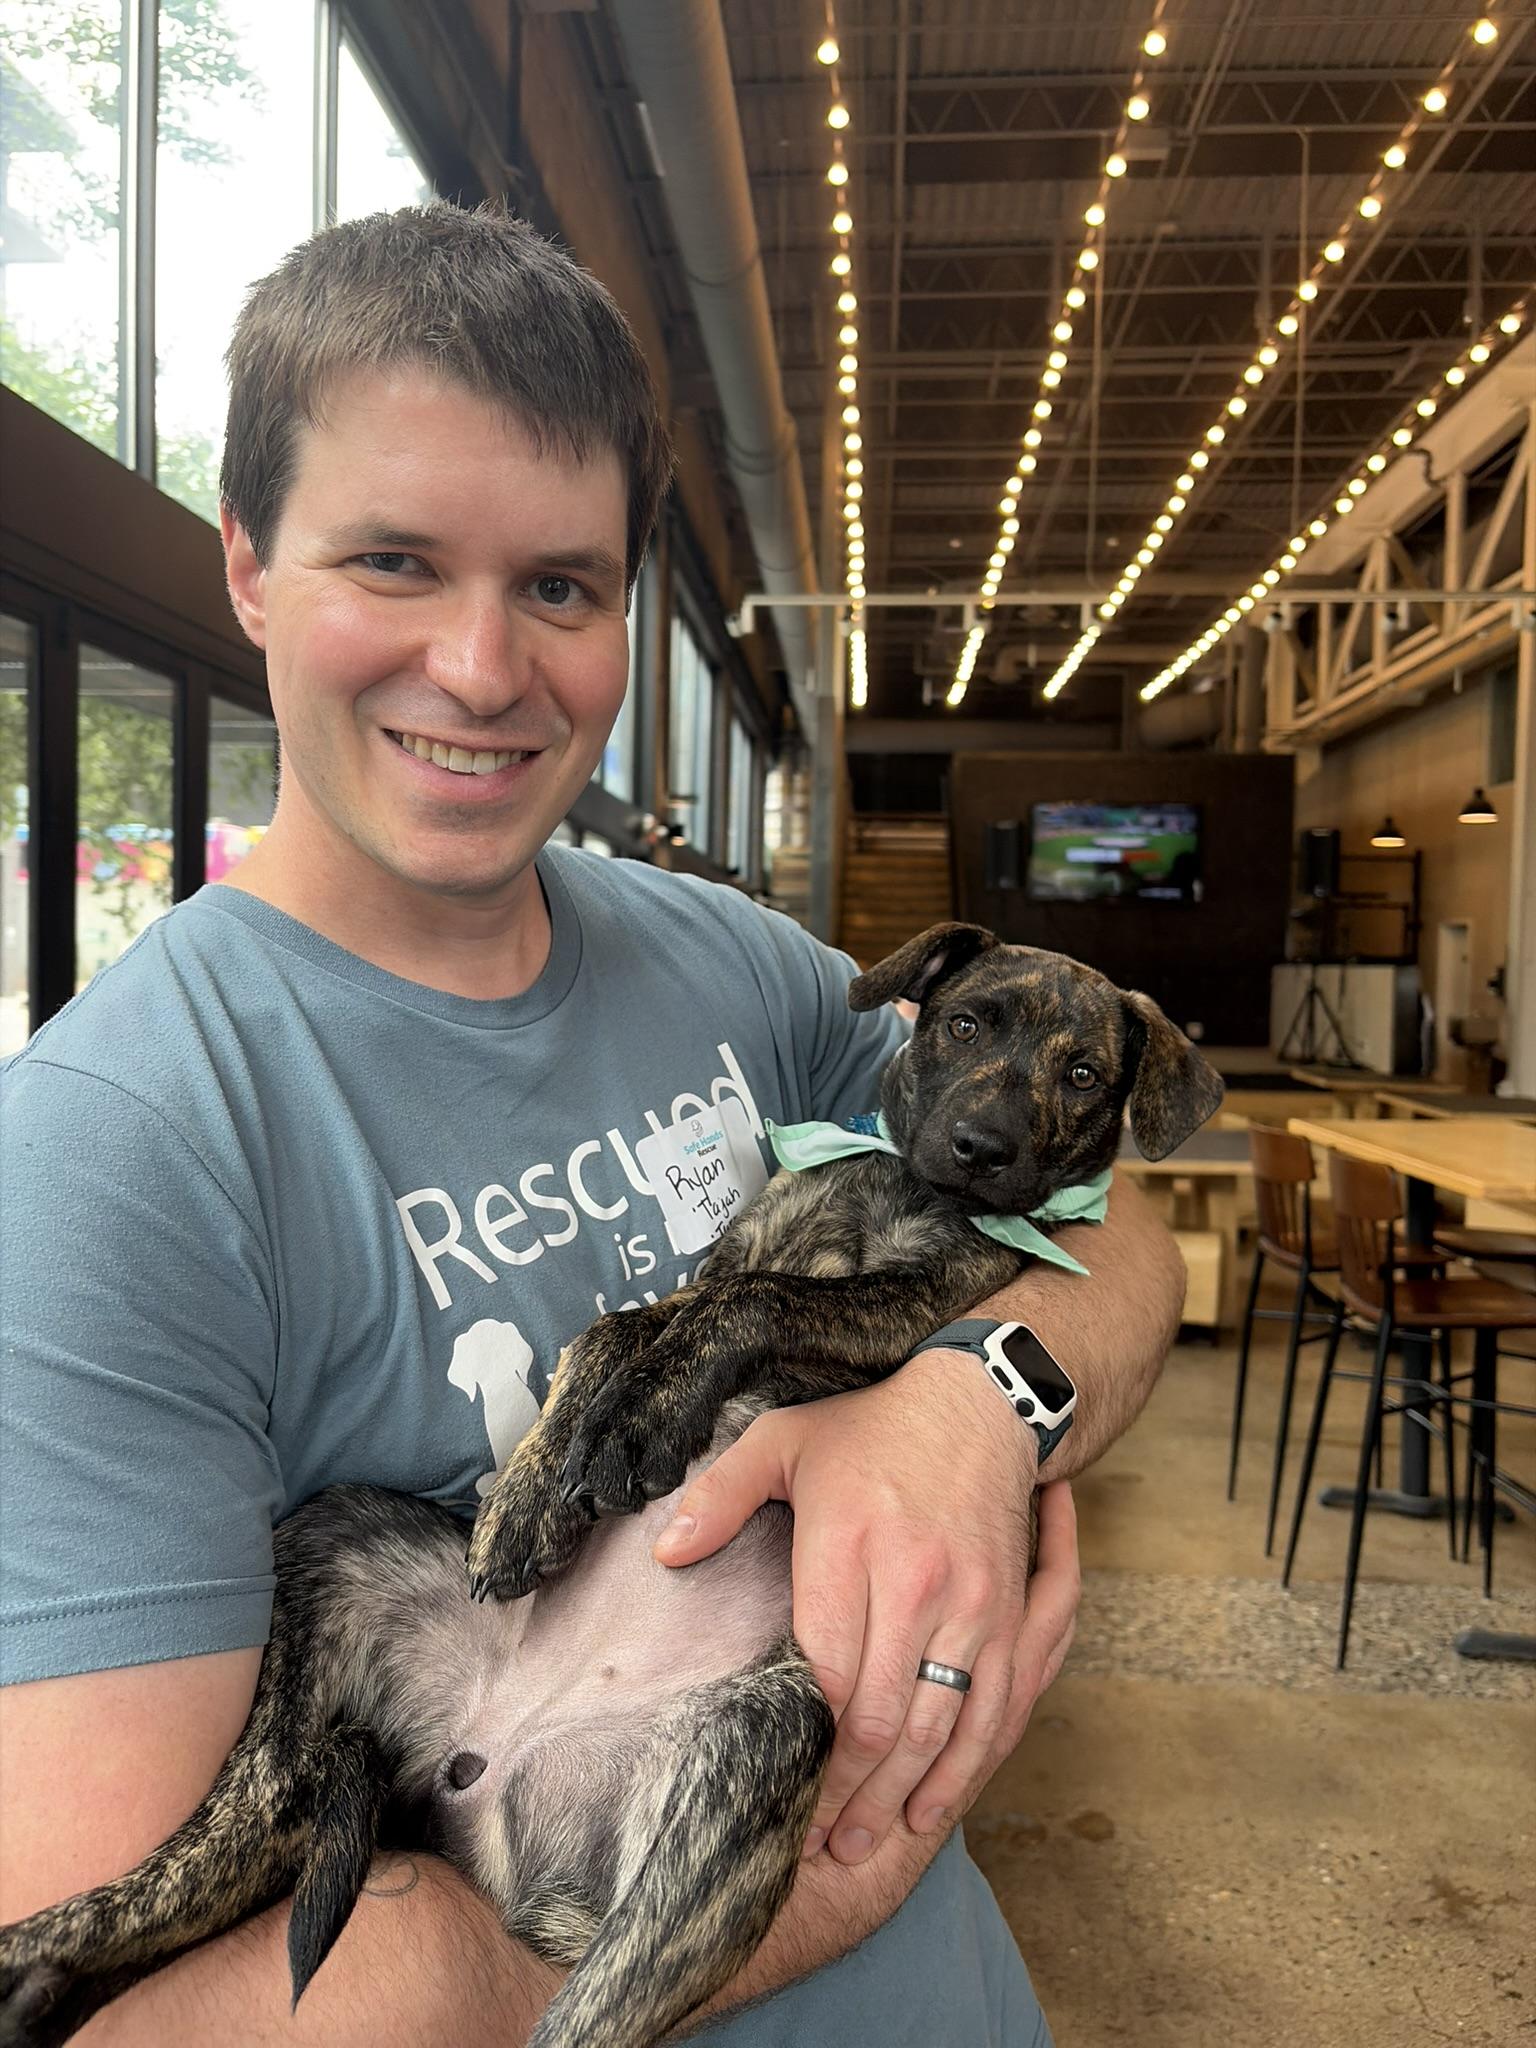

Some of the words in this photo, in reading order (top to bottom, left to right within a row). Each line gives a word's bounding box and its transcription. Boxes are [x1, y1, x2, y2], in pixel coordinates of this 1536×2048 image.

[683, 1141, 701, 1155] Safe
[700, 1130, 724, 1146] Hands
[697, 1144, 717, 1157] Rescue
[665, 1158, 725, 1207] Ryan
[614, 1232, 657, 1281] is
